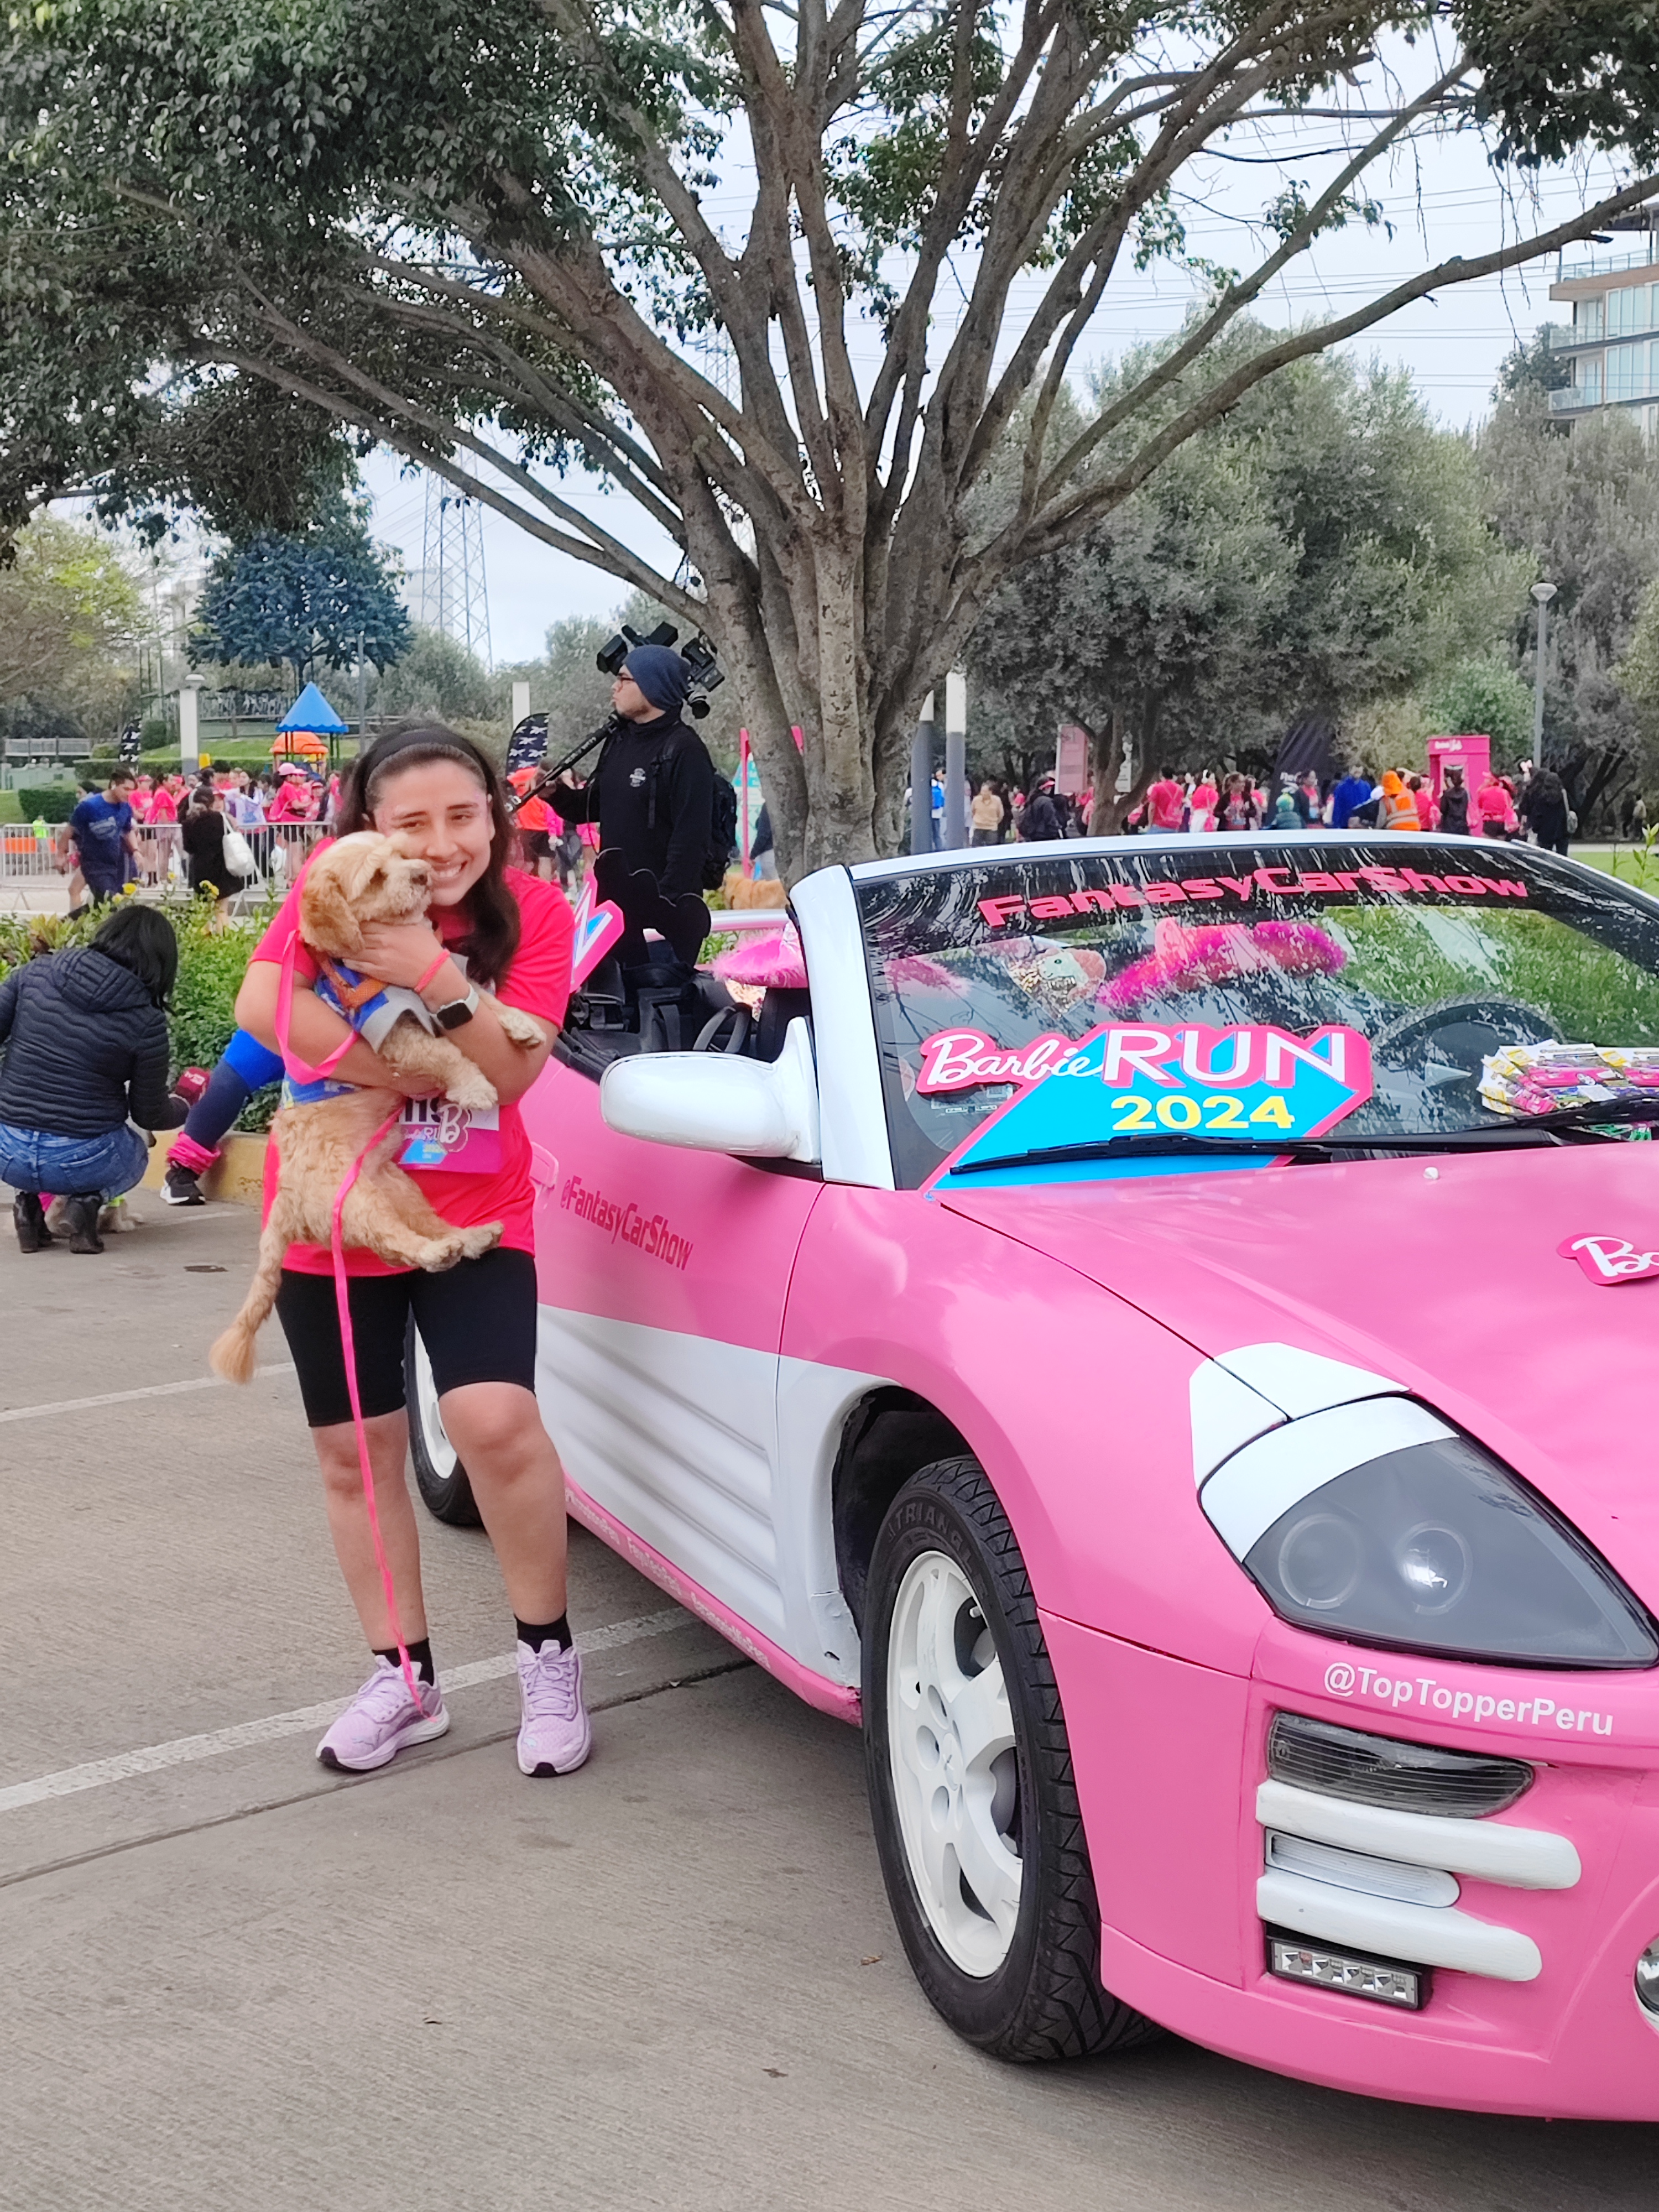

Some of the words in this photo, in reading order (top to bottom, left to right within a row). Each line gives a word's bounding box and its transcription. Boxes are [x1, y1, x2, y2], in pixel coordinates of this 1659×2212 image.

[977, 867, 1528, 927] FantasyCarShow
[926, 1034, 1104, 1085] Barbie
[1103, 1029, 1345, 1083] RUN
[1110, 1095, 1295, 1130] 2024
[560, 1175, 693, 1271] @FantasyCarShow
[1324, 1662, 1614, 1736] @TopTopperPeru
